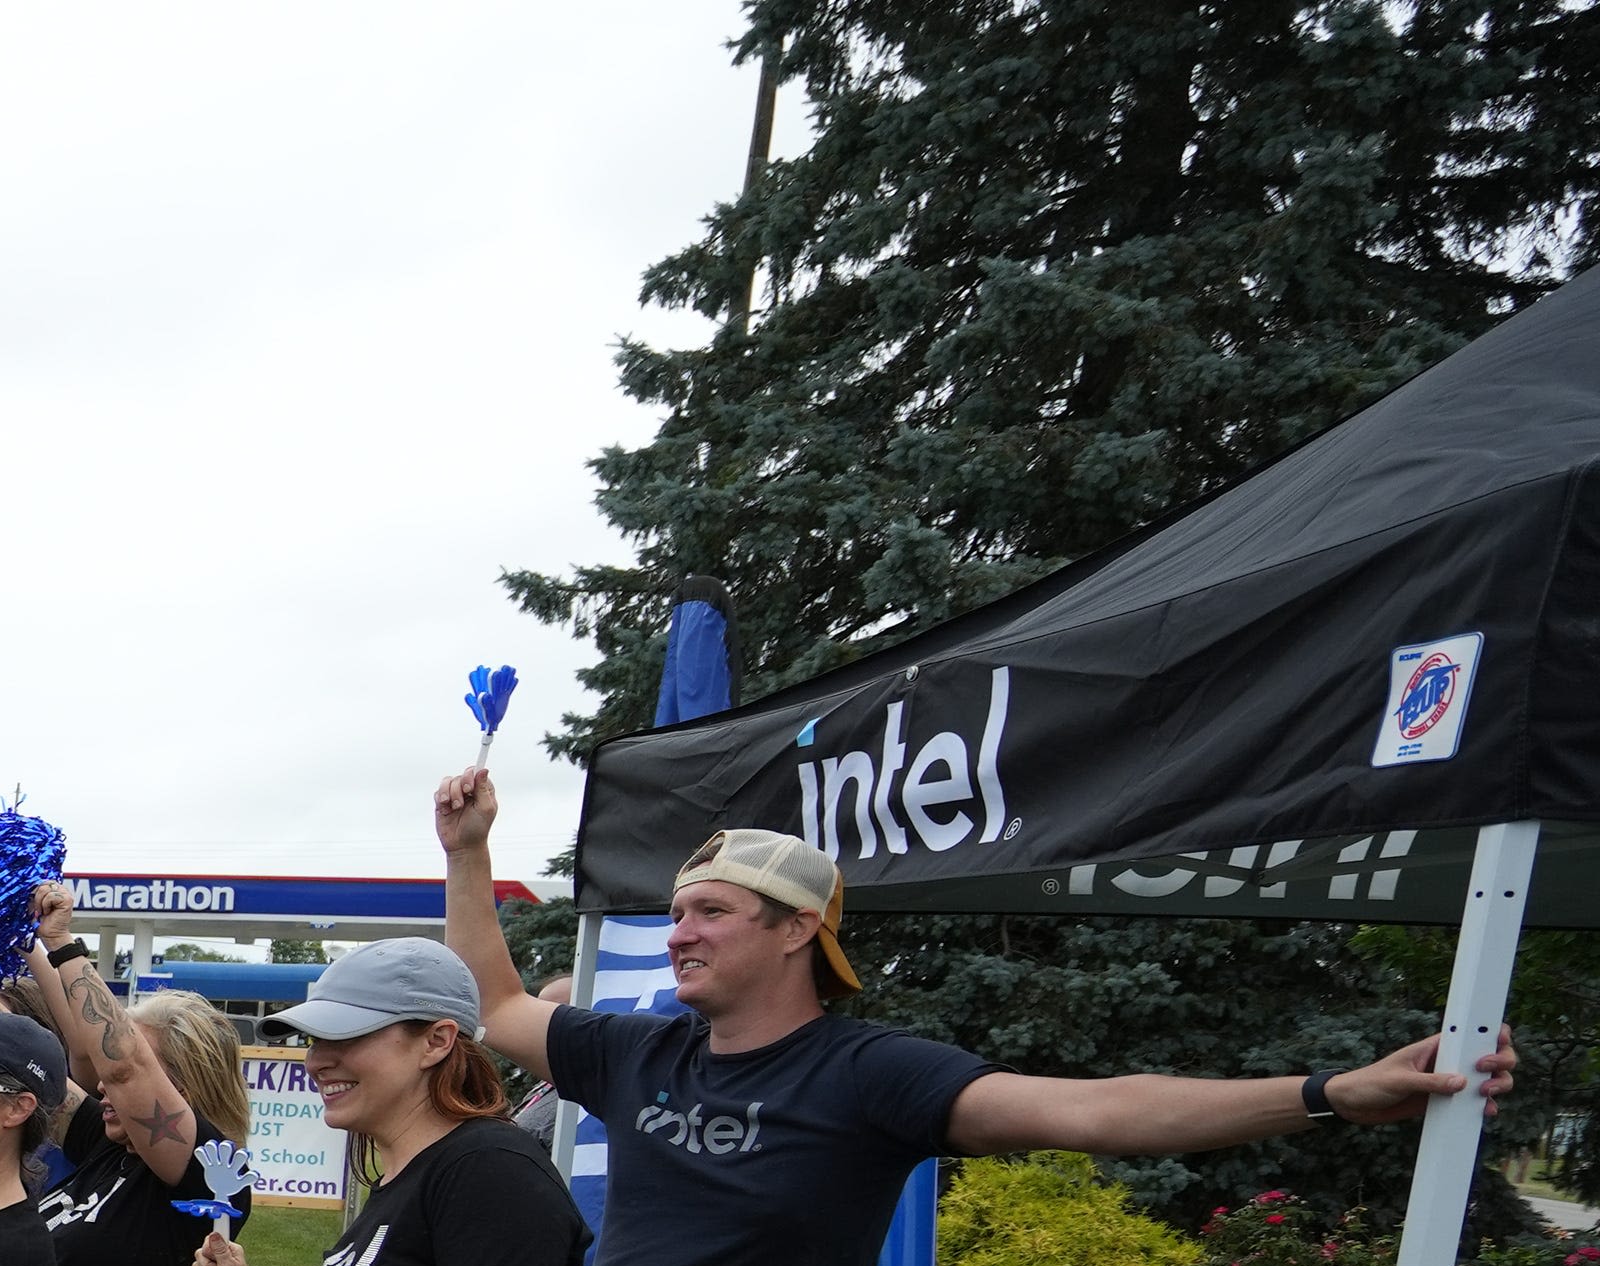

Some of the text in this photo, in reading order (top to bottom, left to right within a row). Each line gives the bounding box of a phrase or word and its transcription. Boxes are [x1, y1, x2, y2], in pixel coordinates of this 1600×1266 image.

[795, 666, 1010, 862] intel
[63, 878, 234, 911] Marathon
[26, 1059, 48, 1082] intel
[635, 1090, 764, 1155] intel
[261, 1149, 325, 1165] School
